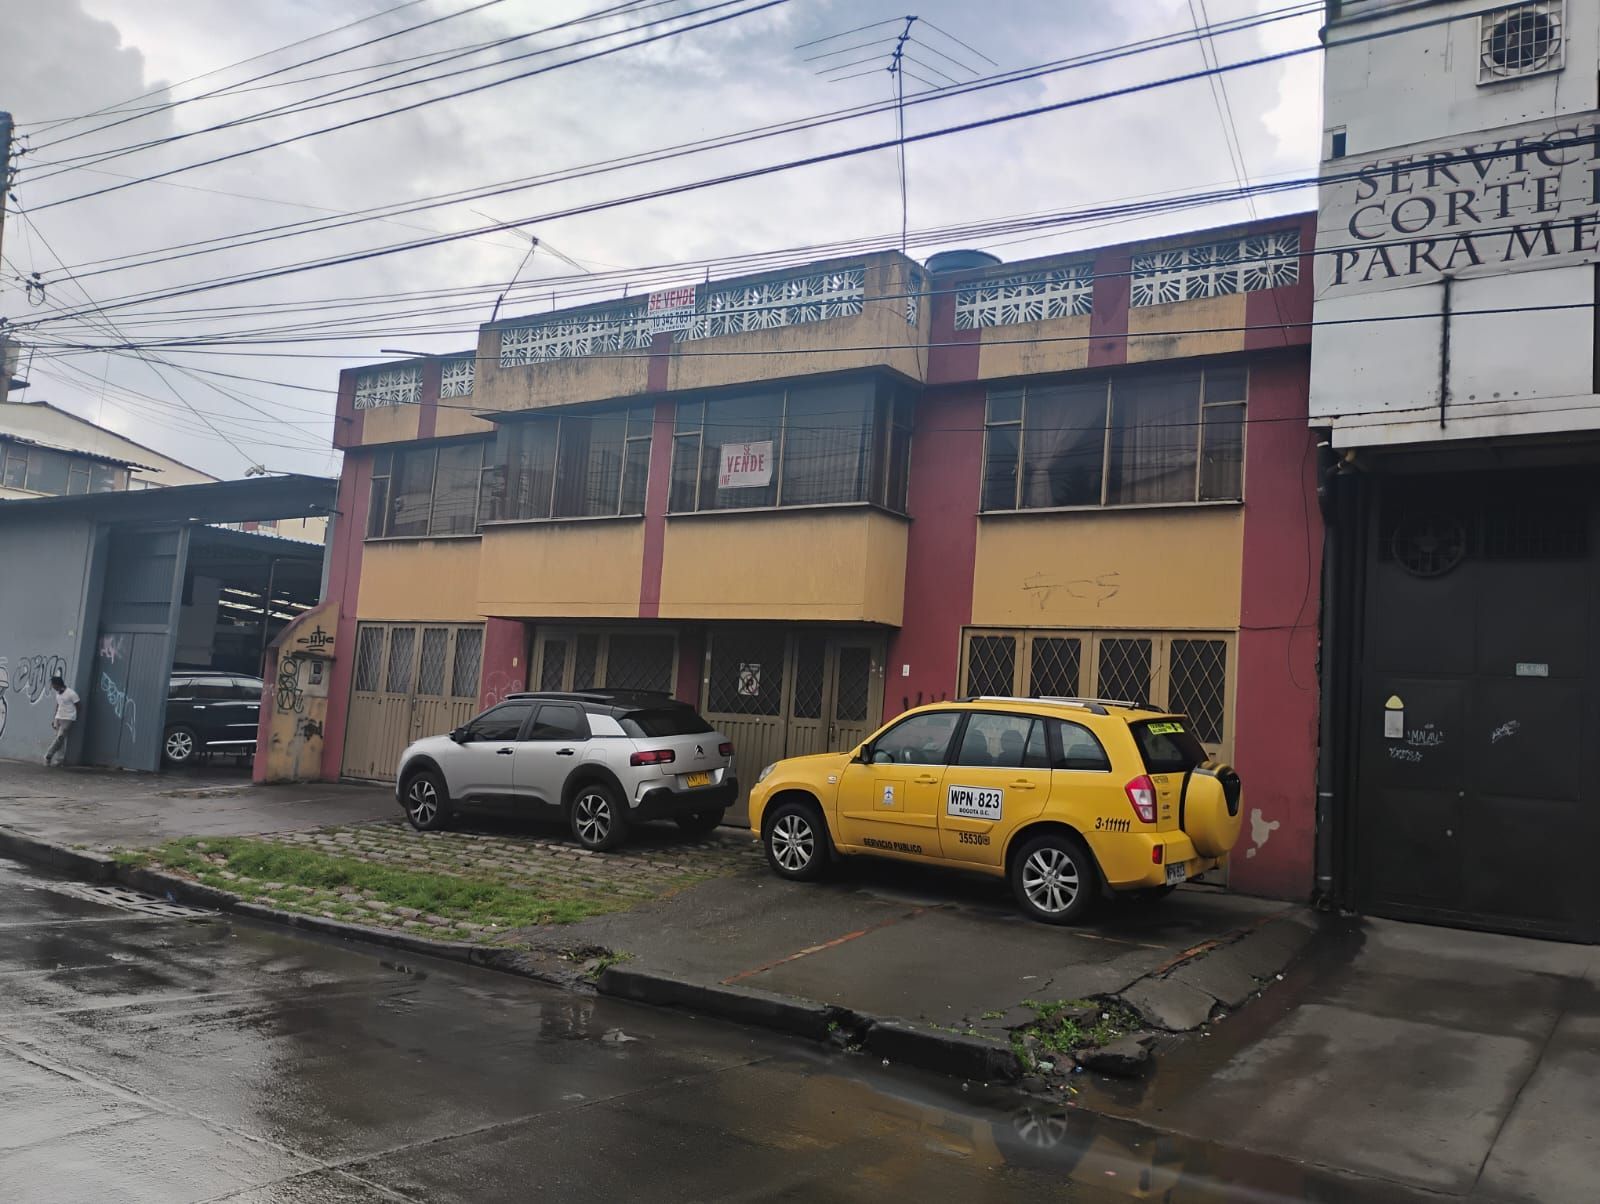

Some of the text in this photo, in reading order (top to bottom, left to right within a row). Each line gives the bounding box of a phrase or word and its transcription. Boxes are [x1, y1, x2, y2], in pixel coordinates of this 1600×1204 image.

[1348, 171, 1561, 241] CORTE
[1330, 231, 1485, 287] PARA
[649, 294, 661, 311] SE
[664, 287, 695, 308] VENDE
[743, 444, 751, 456] SE
[727, 453, 765, 473] VENDE
[951, 789, 1000, 809] WPN 823
[958, 807, 979, 815] BOGOTA
[863, 837, 893, 850] SERVICIO
[959, 832, 983, 846] 35530
